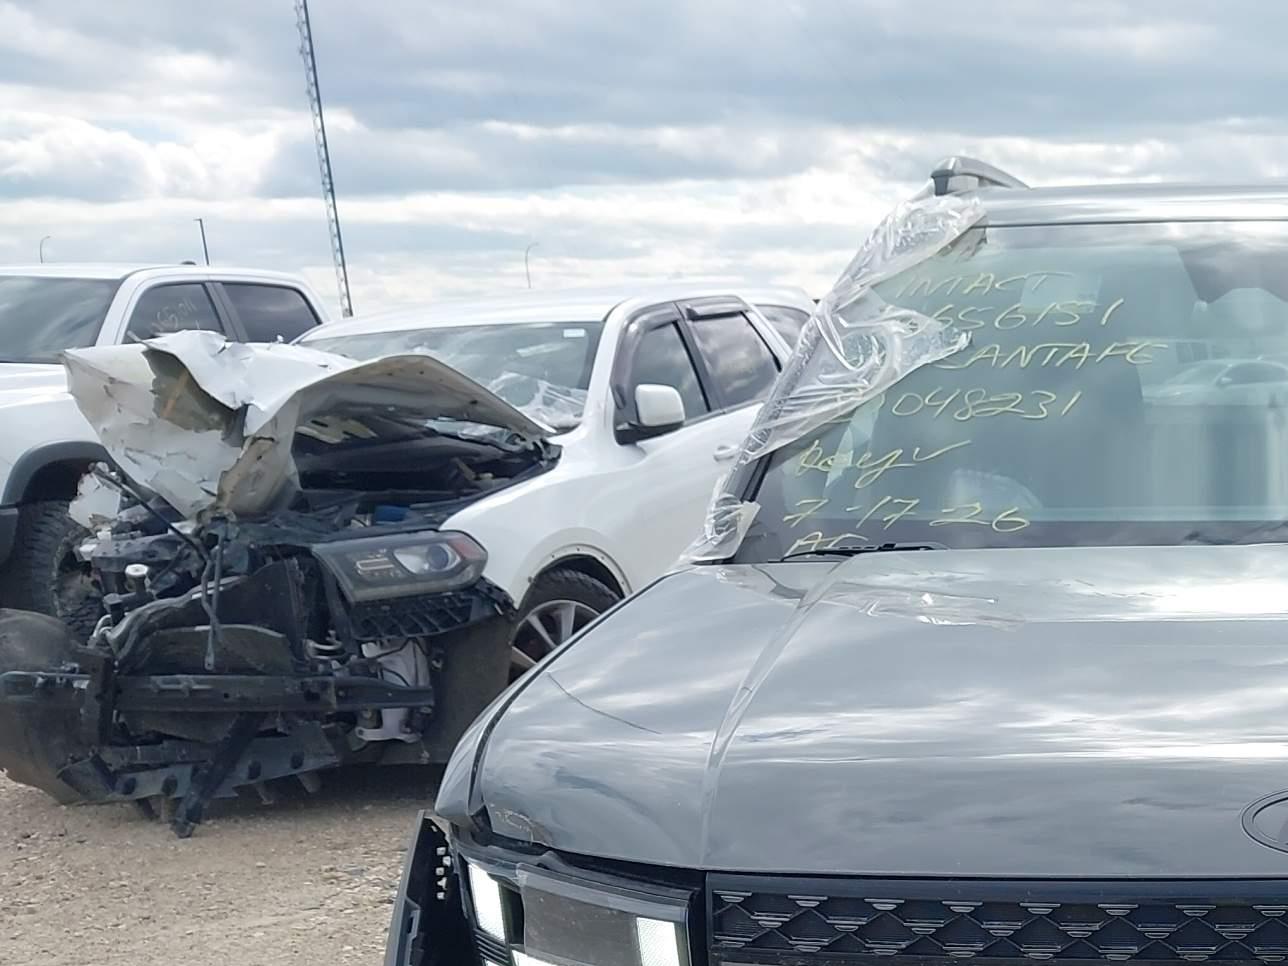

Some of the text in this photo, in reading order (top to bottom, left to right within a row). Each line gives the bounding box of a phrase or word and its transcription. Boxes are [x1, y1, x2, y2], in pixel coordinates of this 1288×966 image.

[895, 271, 1077, 298] INTACT
[932, 341, 1169, 370] ANTAFE
[876, 386, 1083, 422] 048231
